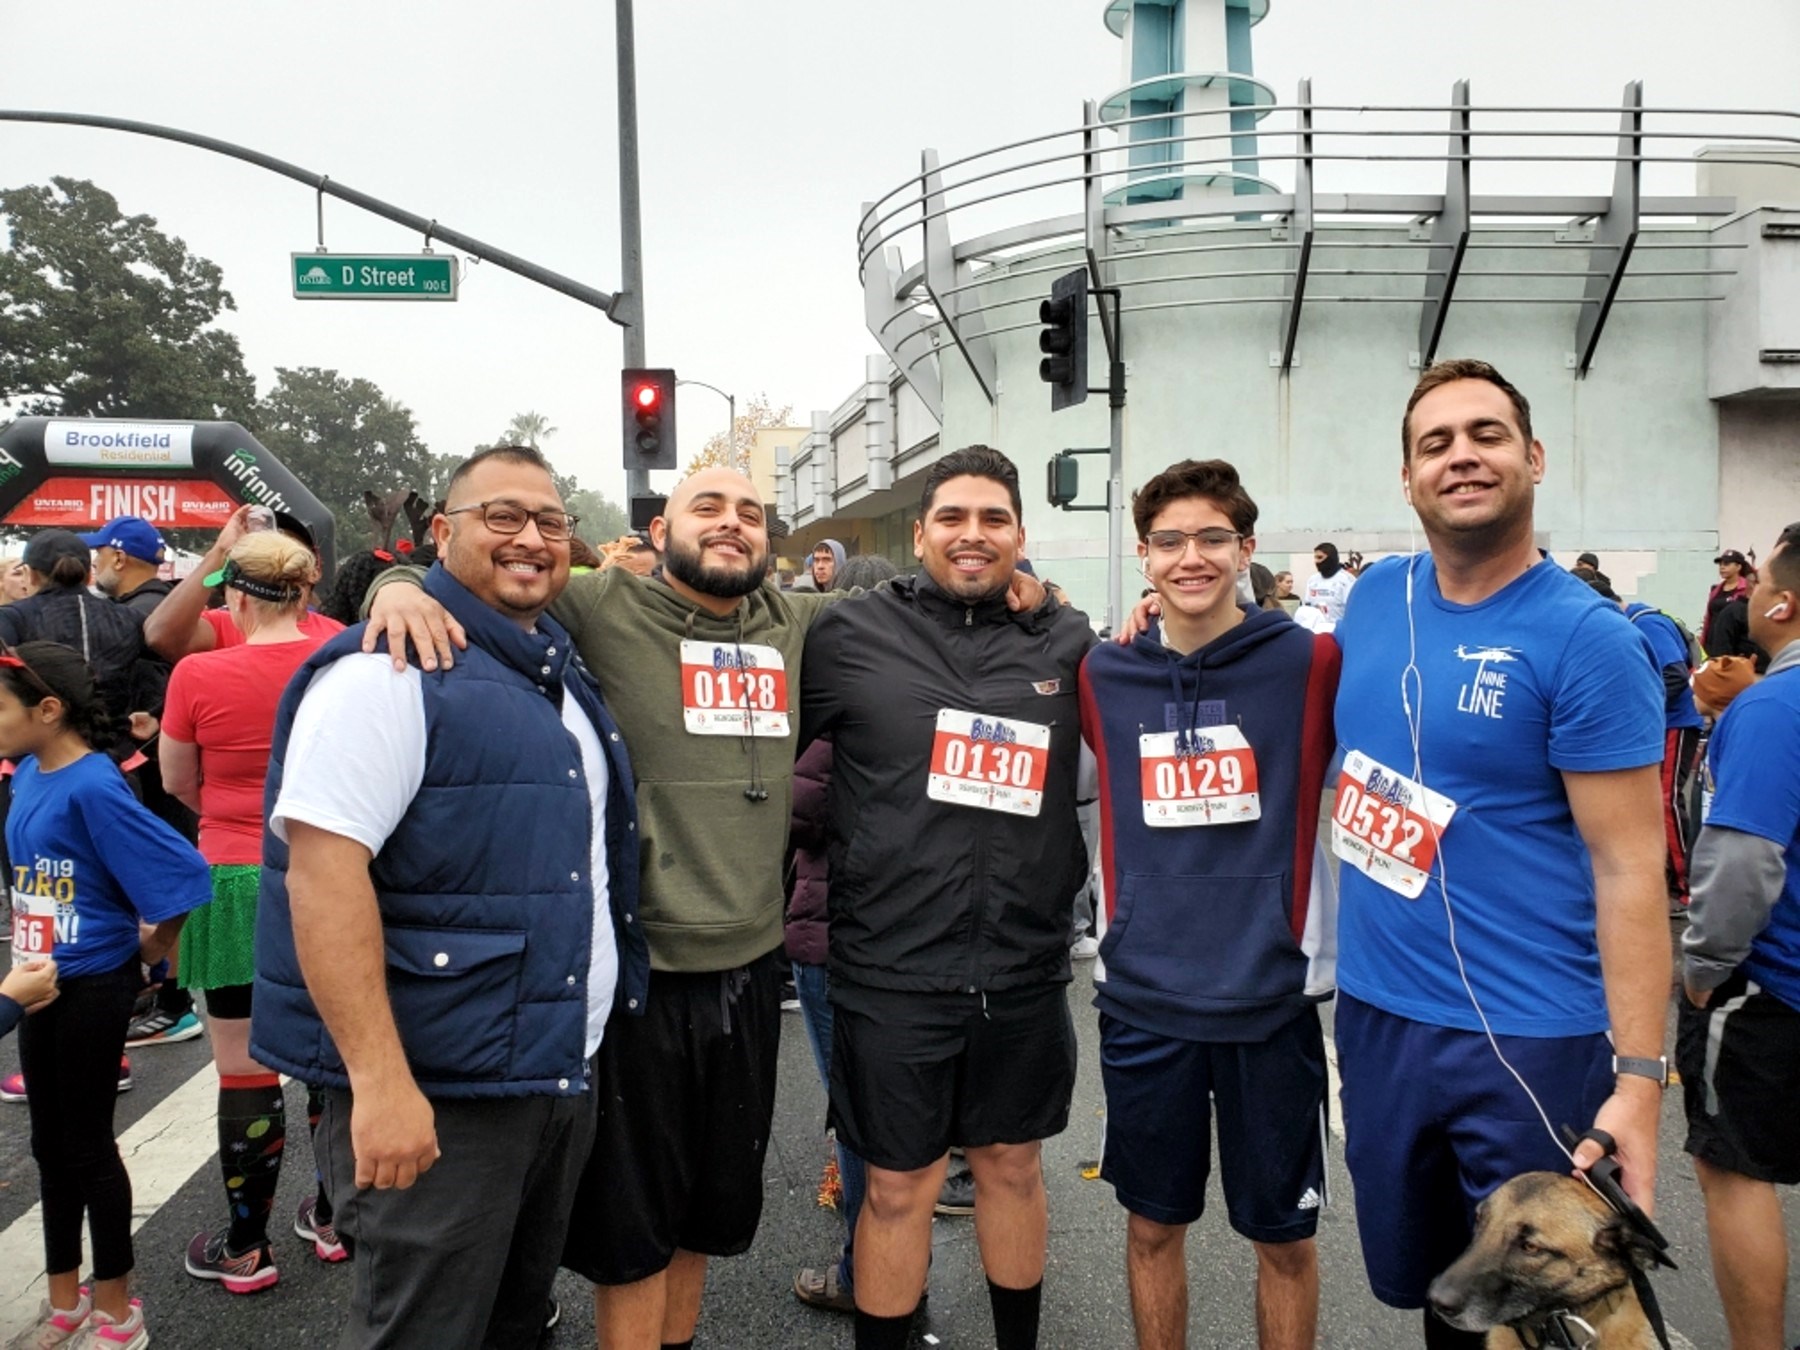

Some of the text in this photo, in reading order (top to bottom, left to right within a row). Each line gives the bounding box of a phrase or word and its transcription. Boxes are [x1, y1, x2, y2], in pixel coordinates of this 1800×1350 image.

[342, 266, 415, 286] D Street
[423, 280, 448, 292] 100 E
[65, 431, 171, 448] Brookfield
[100, 449, 171, 461] Residential
[33, 499, 84, 507] ONTARIO
[90, 484, 176, 521] FINISH
[181, 501, 230, 510] ONTARIO
[694, 670, 776, 710] 0128
[1457, 672, 1506, 719] LINE
[1480, 671, 1508, 689] NINE
[944, 739, 1034, 787] 0130
[1155, 756, 1244, 799] 0129
[1337, 785, 1424, 864] 0532
